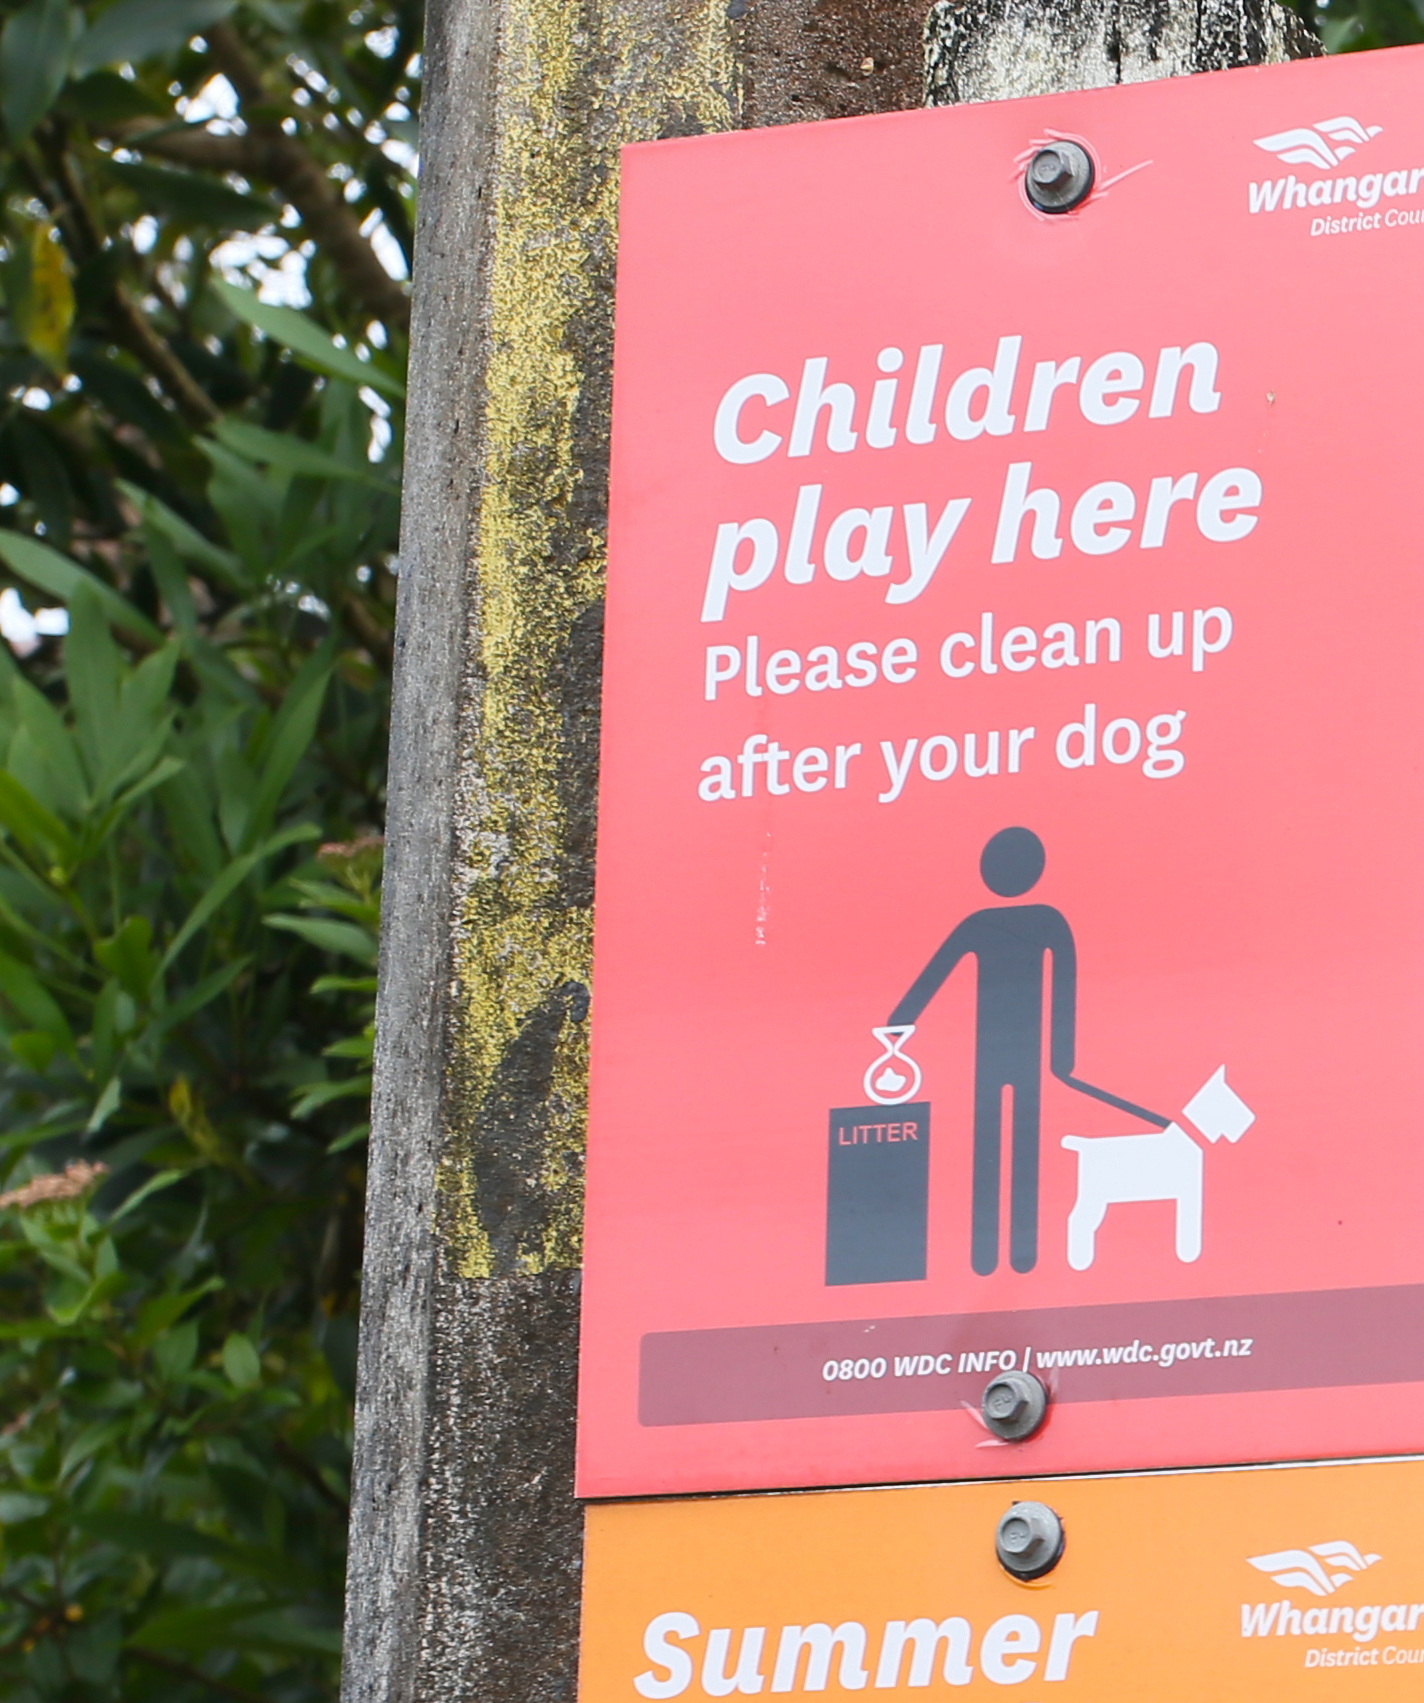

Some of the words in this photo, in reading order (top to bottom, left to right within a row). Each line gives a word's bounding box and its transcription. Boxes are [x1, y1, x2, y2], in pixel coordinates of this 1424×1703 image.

[1311, 212, 1381, 236] District
[714, 335, 1221, 464] Children
[701, 484, 971, 622] play
[991, 462, 1262, 563] here
[705, 636, 917, 700] Please
[941, 612, 1120, 677] clean
[1148, 607, 1232, 671] up
[699, 734, 861, 801] after
[879, 727, 1035, 803] your
[1056, 704, 1186, 778] dog
[838, 1122, 918, 1146] LITTER
[823, 1358, 886, 1380] 0800
[895, 1354, 952, 1376] WDC
[958, 1350, 1016, 1373] INFO
[1037, 1338, 1253, 1368] www.wdc.govt.nz
[634, 1611, 1098, 1699] Summer
[1305, 1646, 1379, 1667] District
